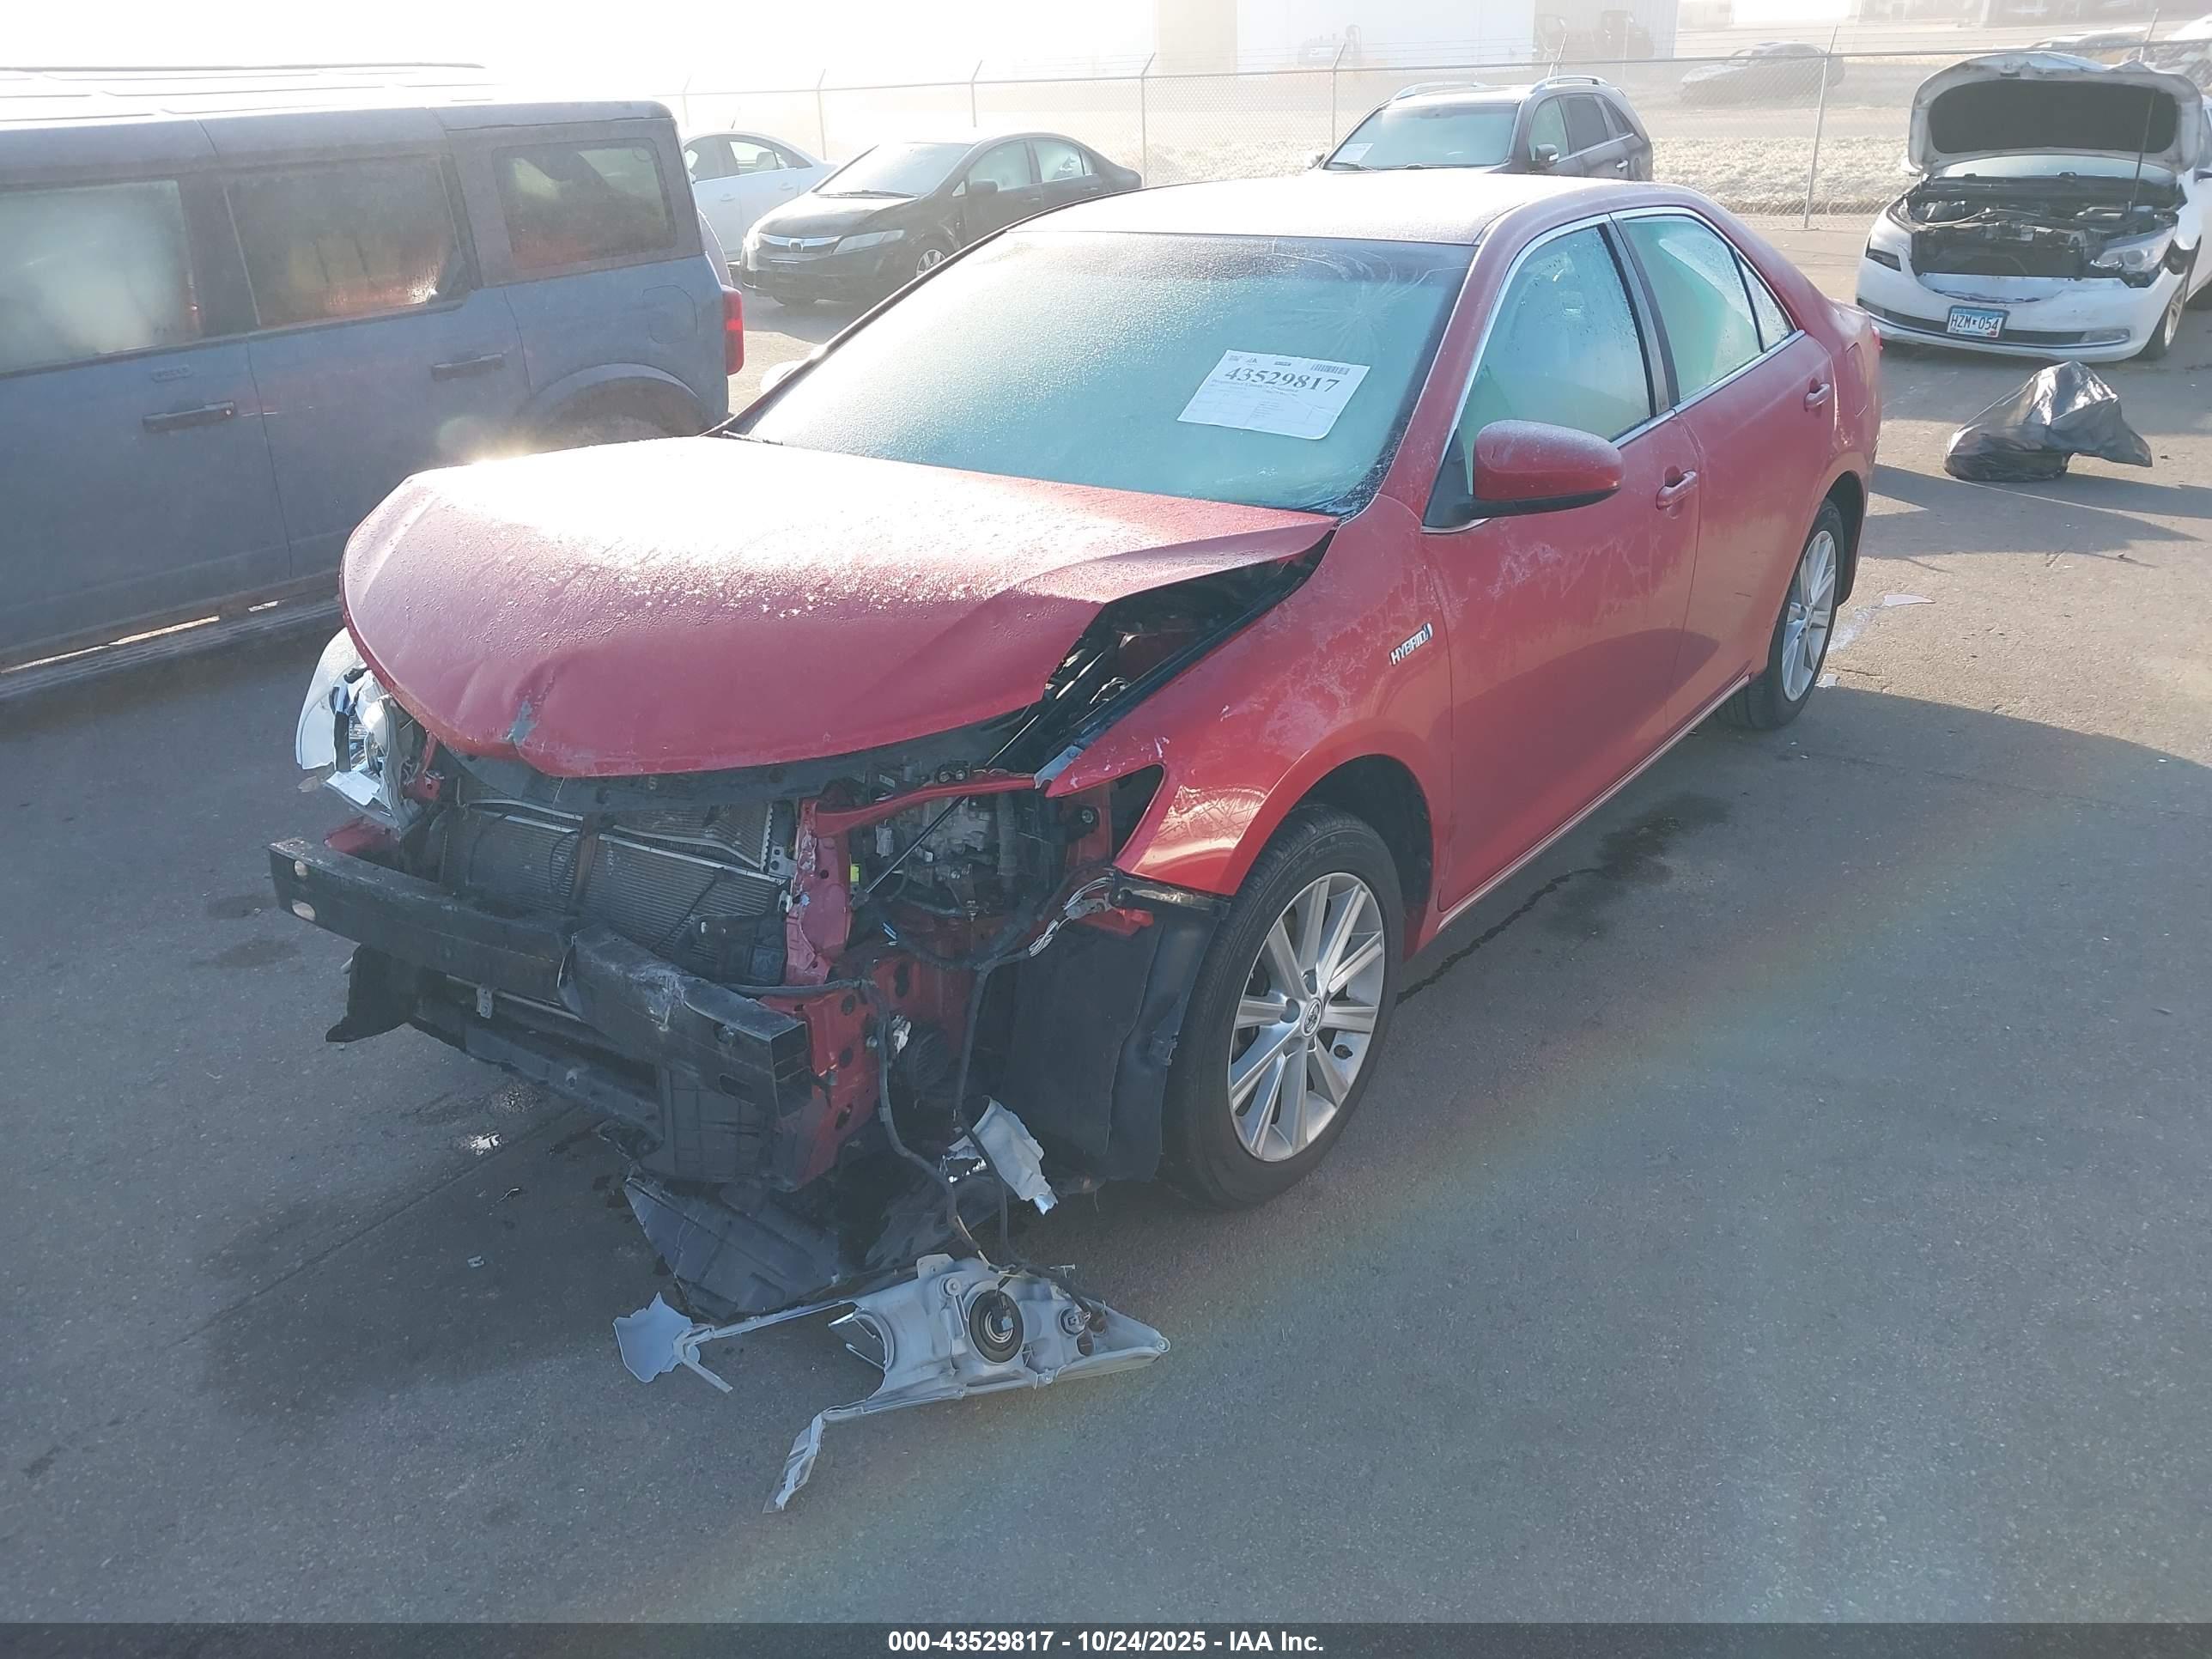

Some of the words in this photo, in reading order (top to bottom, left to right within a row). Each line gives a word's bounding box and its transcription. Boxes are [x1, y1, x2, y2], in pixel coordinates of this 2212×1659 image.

[1950, 313, 1972, 329] HZM
[1978, 316, 2000, 331] 054
[1224, 367, 1340, 392] 43529817
[1390, 629, 1429, 665] HYBRID
